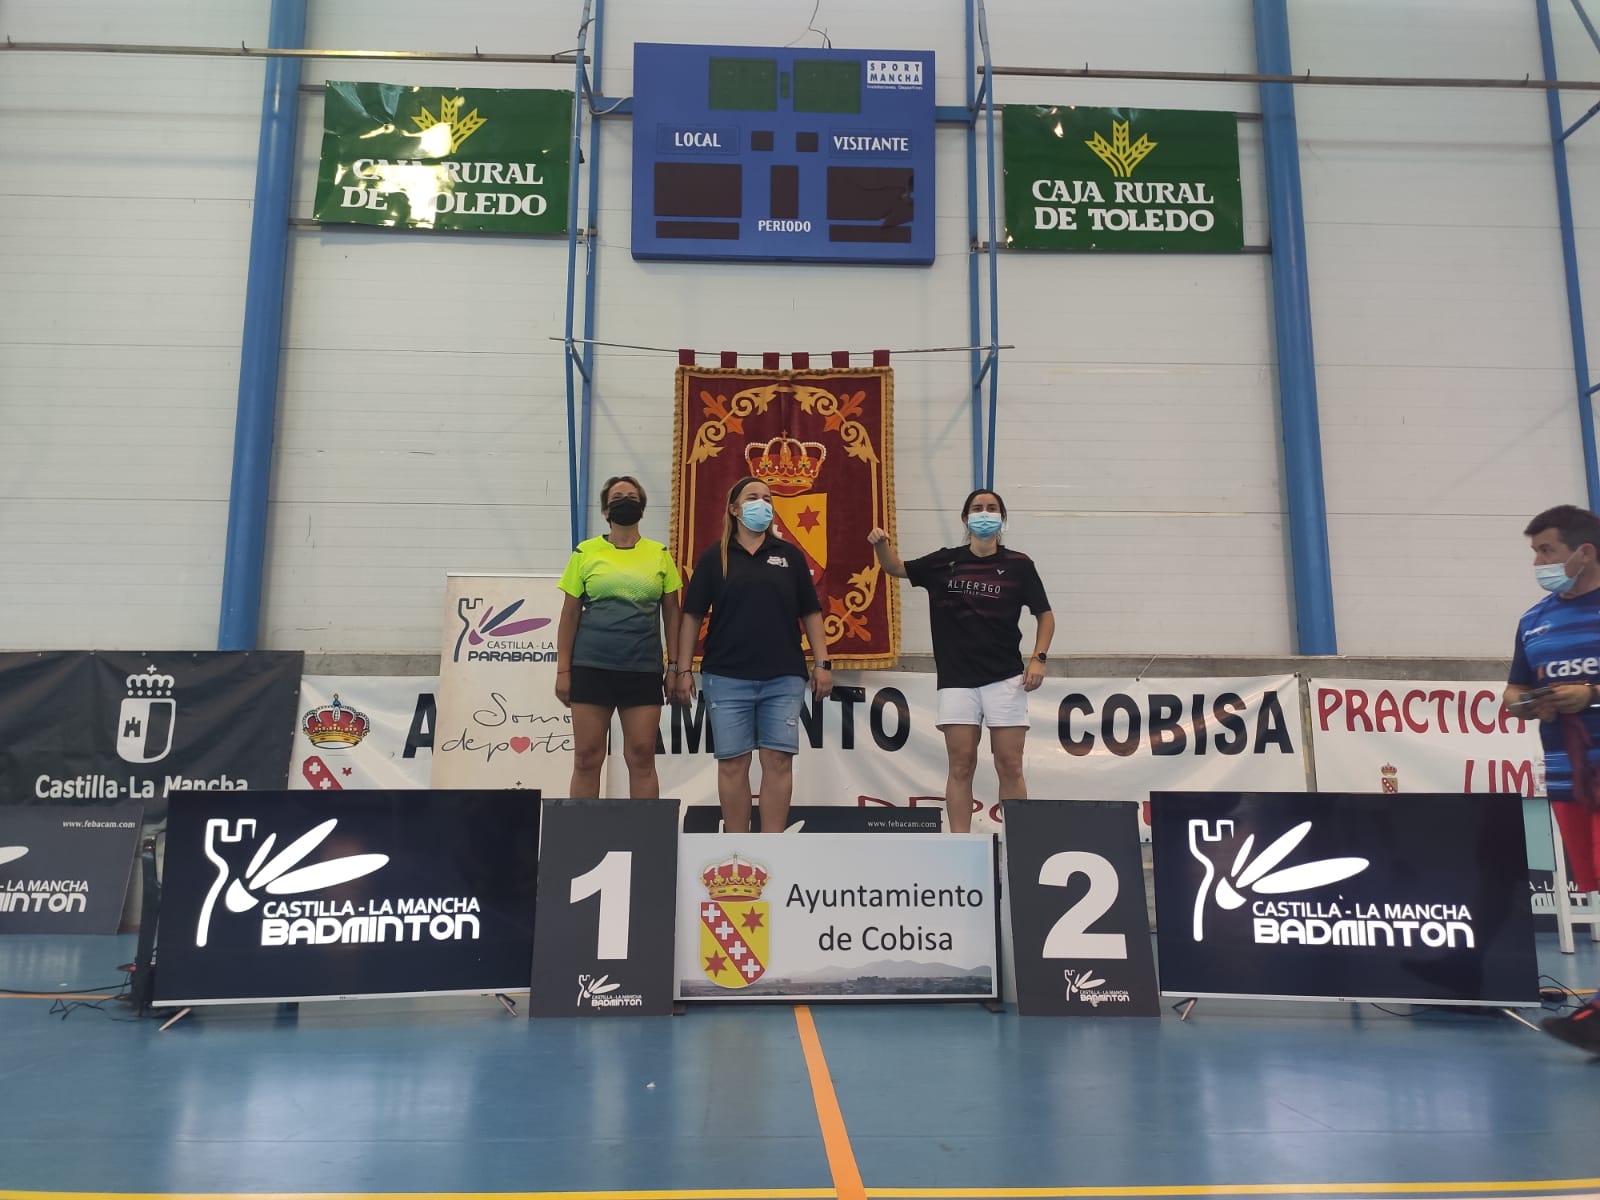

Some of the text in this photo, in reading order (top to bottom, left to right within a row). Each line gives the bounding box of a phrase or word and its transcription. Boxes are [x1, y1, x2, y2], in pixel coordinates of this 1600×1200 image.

[870, 62, 920, 72] SPORT
[870, 73, 920, 82] MANCHA
[675, 132, 722, 148] LOCAL
[833, 135, 909, 152] VISITANTE
[340, 186, 548, 217] DE OLEDO
[1031, 179, 1215, 205] CAJA RURAL
[758, 219, 812, 233] PERIODO
[1034, 206, 1215, 233] DE TOLEDO
[487, 640, 534, 649] CASTILLA
[541, 641, 554, 649] LA
[1546, 656, 1600, 678] case
[472, 692, 572, 728] Somo
[1058, 691, 1294, 757] COBISA
[62, 820, 136, 829] www.febacam.com
[6, 880, 25, 892] LA
[27, 880, 89, 892] MANCHA
[0, 892, 88, 913] INTON
[263, 900, 355, 918] CASTILLA
[369, 899, 393, 916] LA
[397, 897, 481, 915] MANCHA
[570, 851, 632, 960] 1
[786, 883, 983, 914] Ayuntamiento
[1038, 851, 1128, 960] 2
[1252, 901, 1343, 918] CASTILLA
[1356, 903, 1381, 919] LA
[1384, 904, 1473, 921] MANCHA
[261, 914, 481, 946] BADMINTON
[818, 925, 953, 952] de Cobisa
[1253, 917, 1475, 948] BADMINTON
[591, 999, 642, 1007] BADMINTON
